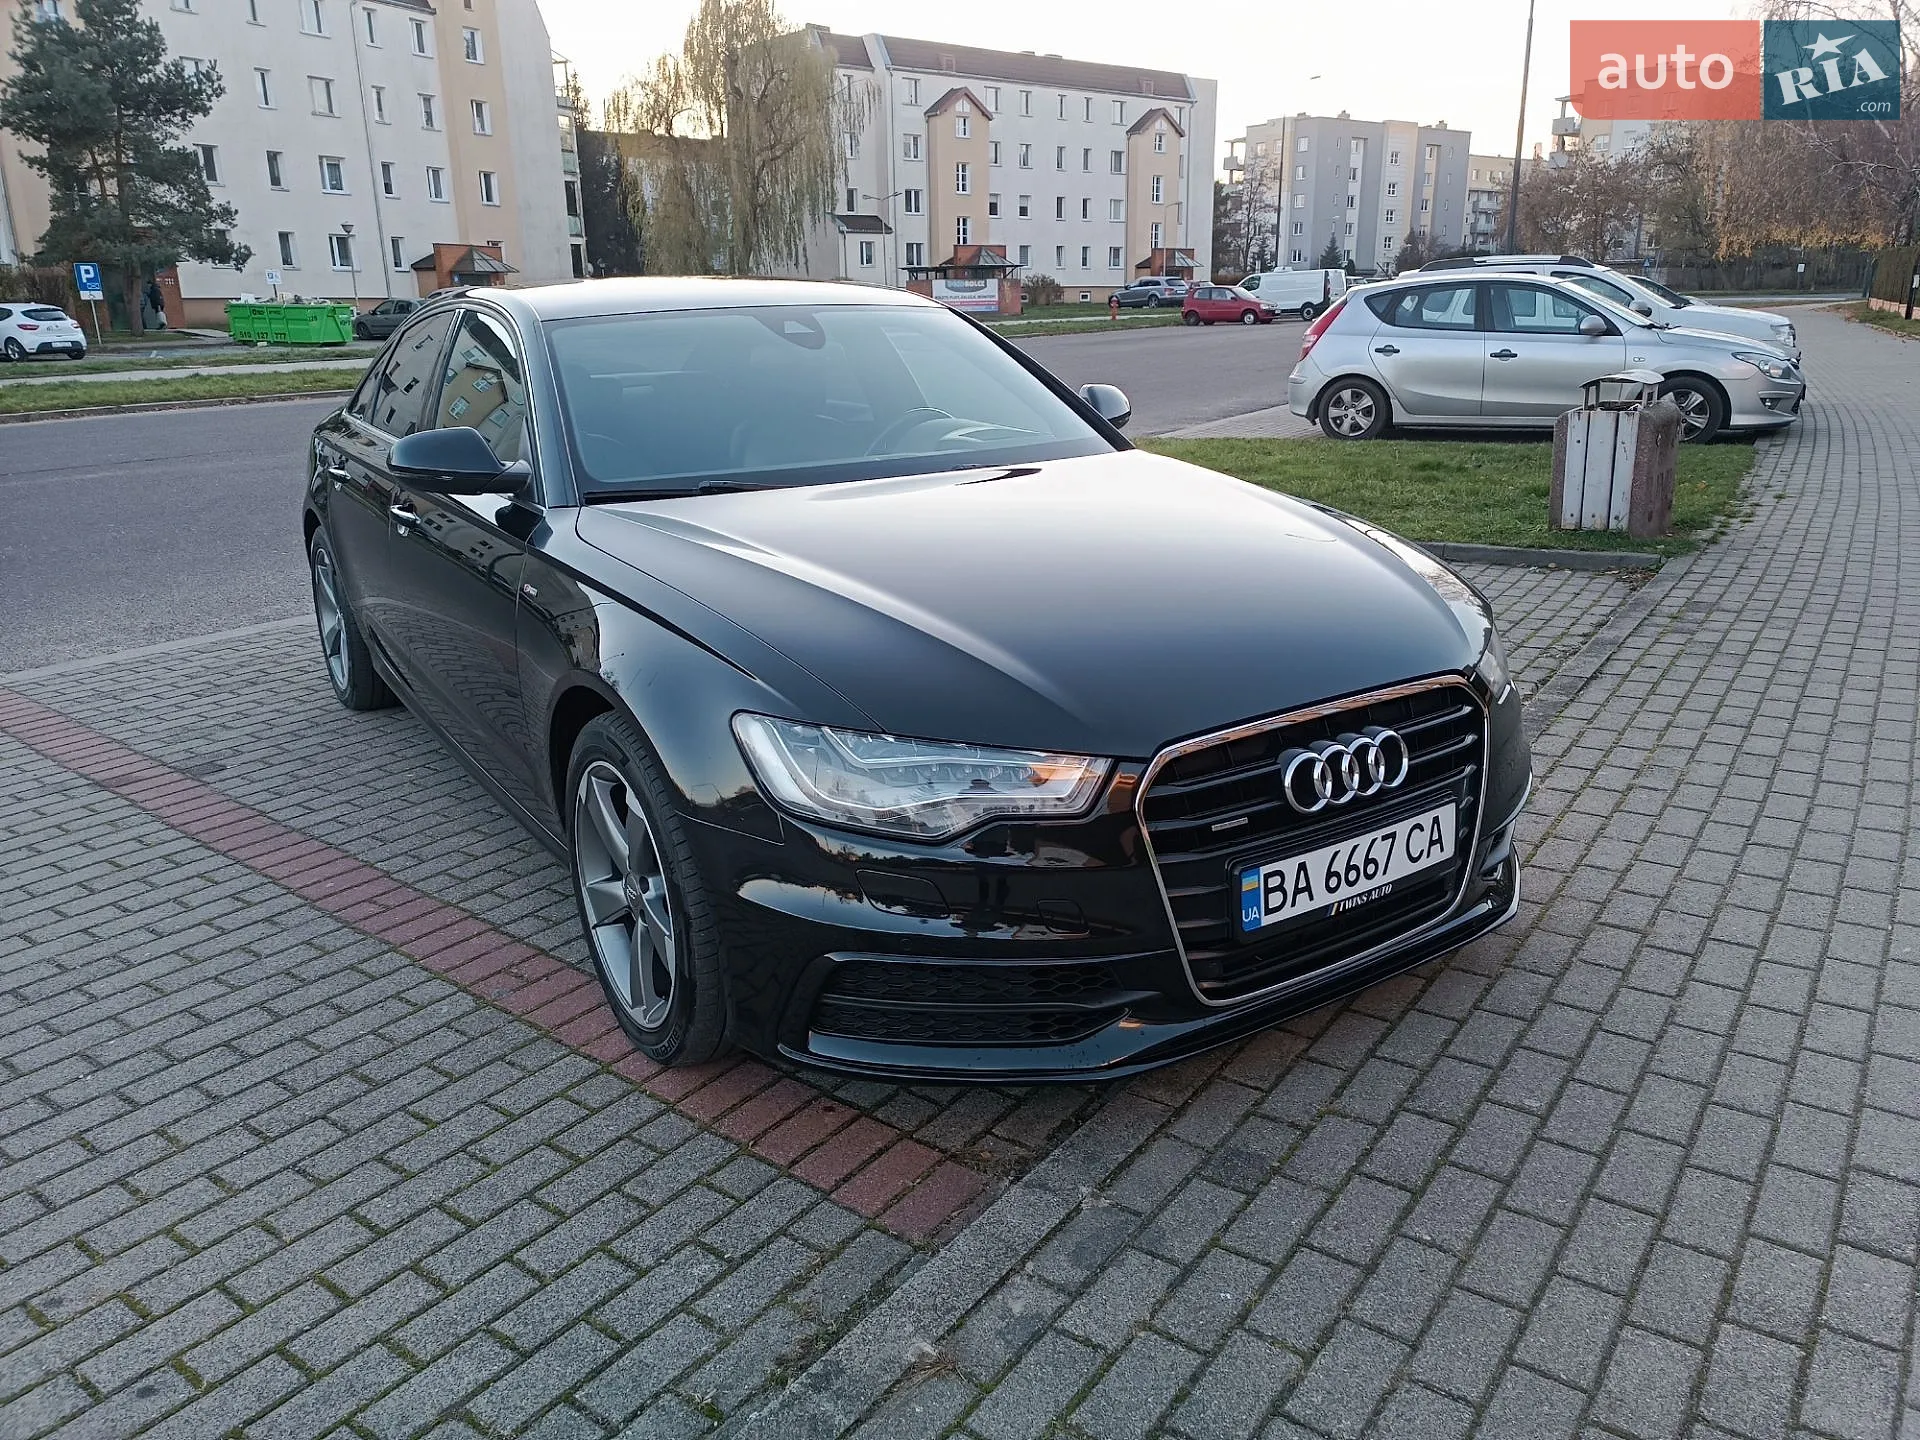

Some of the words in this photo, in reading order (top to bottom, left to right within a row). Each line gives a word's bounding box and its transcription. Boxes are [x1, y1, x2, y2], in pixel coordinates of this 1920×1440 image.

[80, 265, 95, 283] P
[257, 331, 269, 339] 127
[274, 332, 287, 340] 777
[1263, 860, 1314, 917] BA
[1324, 830, 1398, 895] 6667
[1405, 814, 1445, 865] CA
[1339, 892, 1368, 912] TWINS
[1368, 883, 1393, 902] AUTO
[1242, 908, 1260, 922] UA
